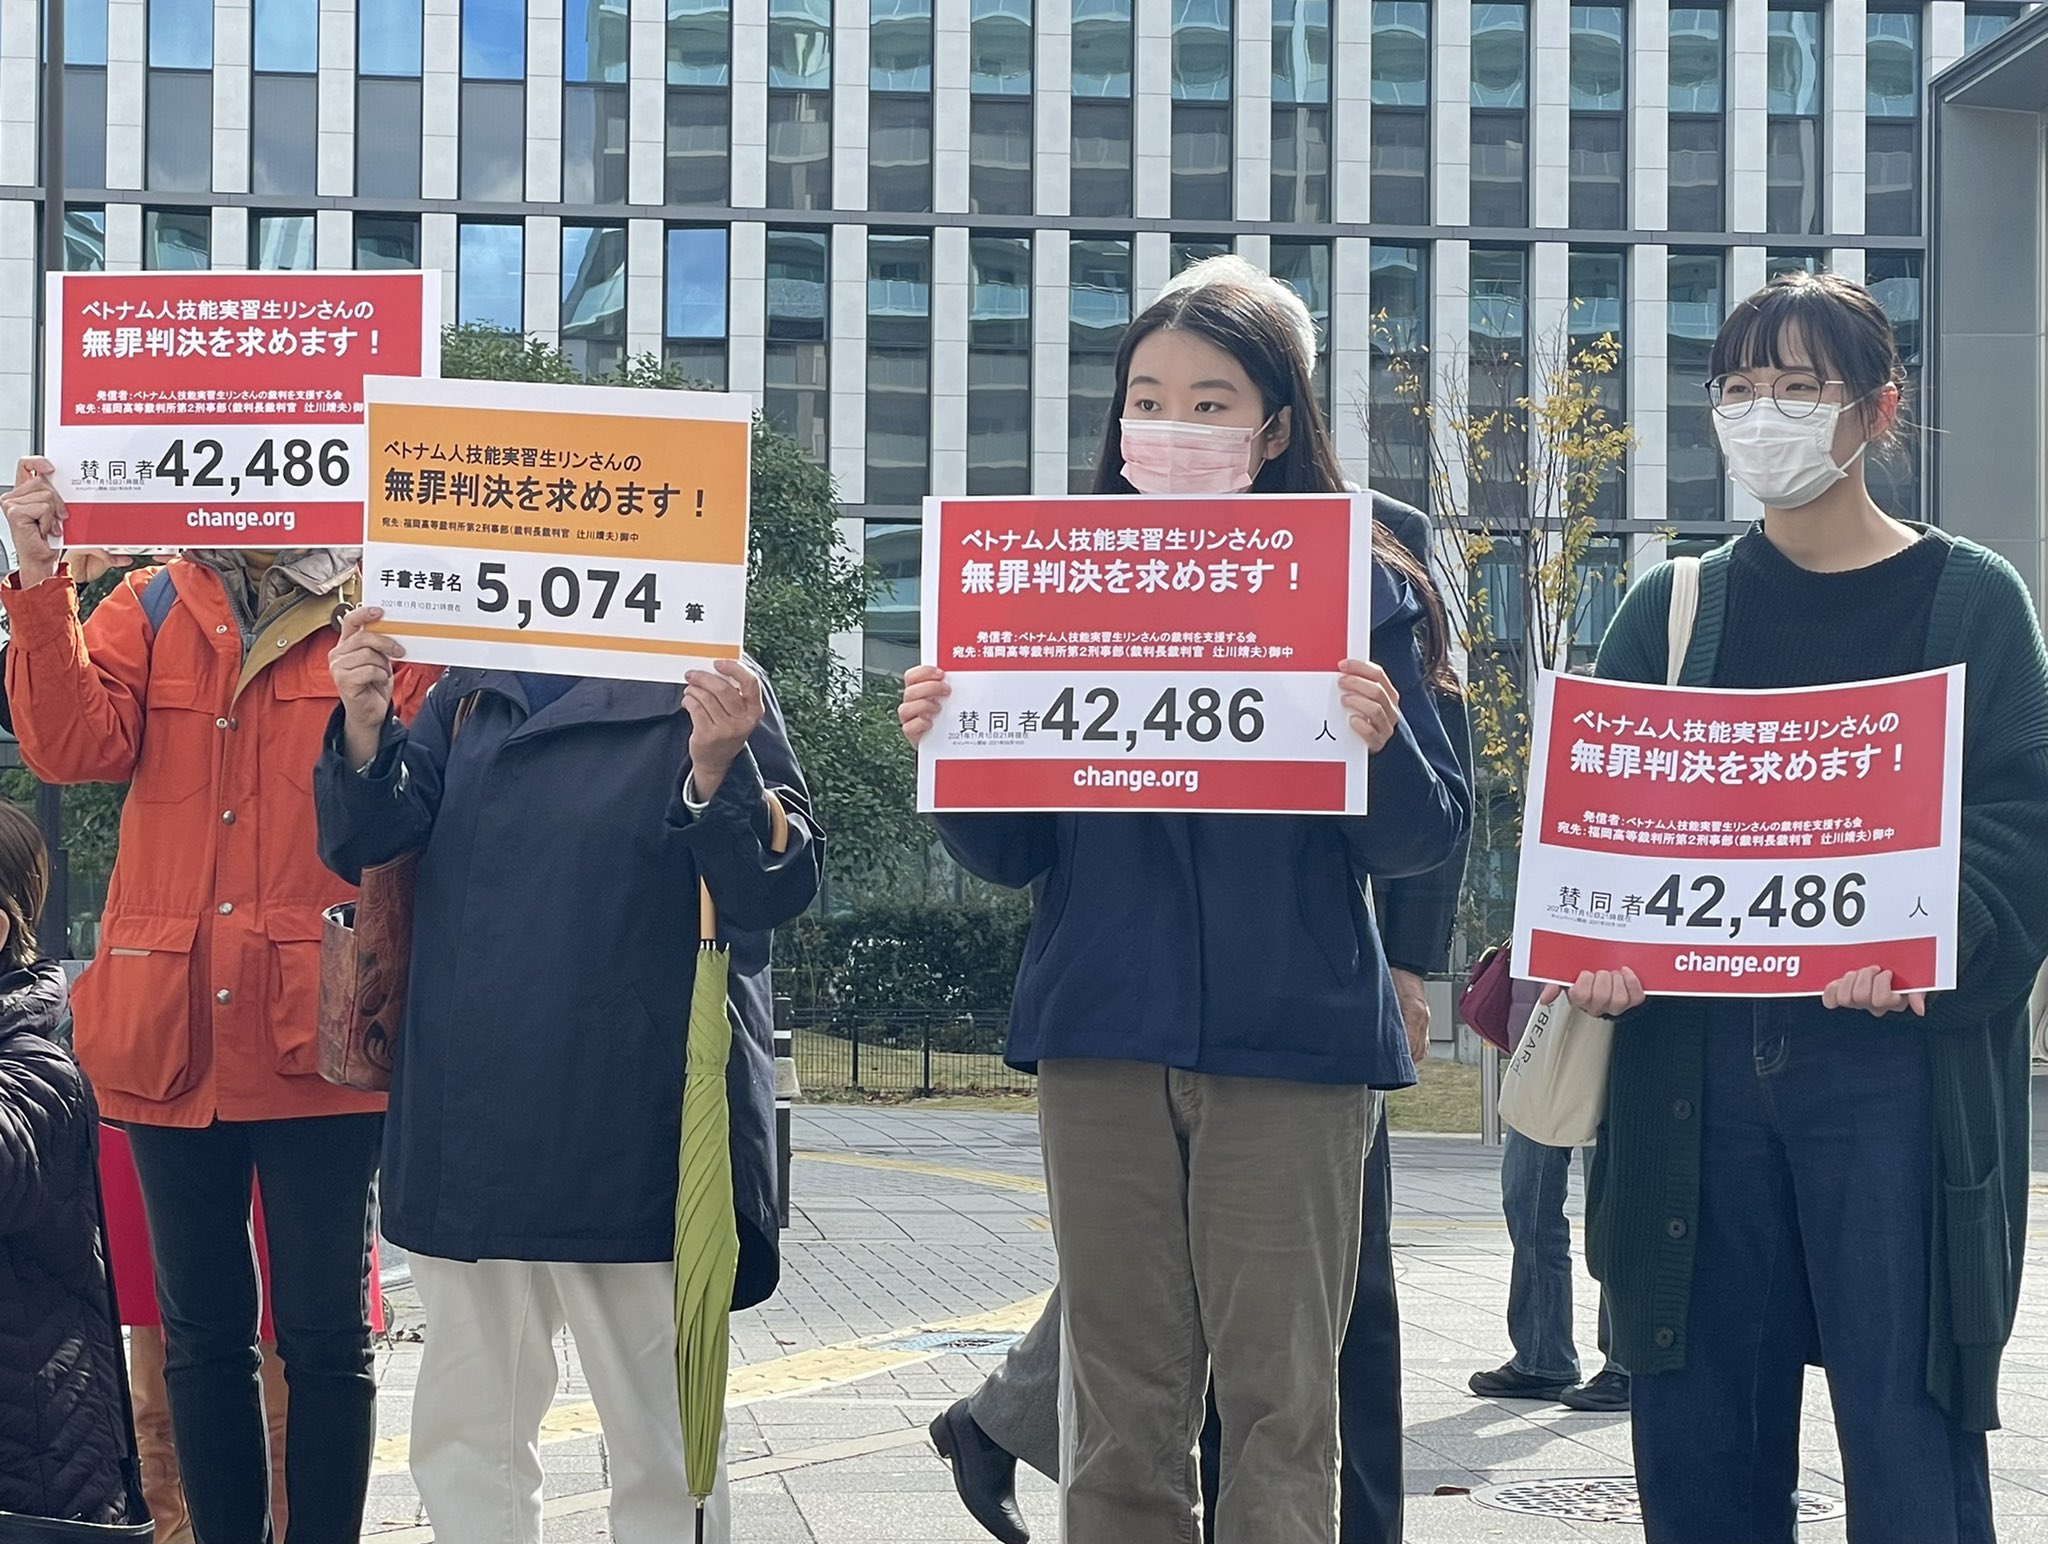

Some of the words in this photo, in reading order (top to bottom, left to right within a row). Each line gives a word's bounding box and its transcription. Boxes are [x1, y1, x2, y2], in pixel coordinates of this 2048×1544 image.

[81, 299, 374, 321] ベトナム人技能実習生リンさんの
[82, 326, 379, 359] 無罪判決を求めます！
[80, 459, 155, 481] 賛同者
[155, 439, 350, 496] 42,486
[384, 440, 642, 473] ベトナム人技能実習生リンさんの
[384, 466, 705, 519] 無罪判決を求めます！
[187, 508, 295, 531] change.org
[960, 527, 1294, 552] ベトナム人技能実習生リンさんの
[961, 559, 1299, 594] 無罪判決を求めます！
[380, 568, 461, 592] 手書き署名
[476, 562, 662, 630] 5,074
[685, 602, 705, 623] 筆
[959, 710, 1041, 734] 賛同者
[1041, 687, 1265, 753] 42,486
[1314, 719, 1337, 741] 人
[1573, 709, 1900, 744] ベトナム人技能実習生リンさんの
[1073, 765, 1199, 792] change.org
[1570, 738, 1903, 785] 無罪判決を求めます！
[1559, 885, 1645, 916] 賛同者
[1645, 872, 1867, 939] 42,486
[1908, 896, 1929, 919] 人
[1674, 951, 1800, 977] change.org
[1520, 1012, 1549, 1063] BEAR
